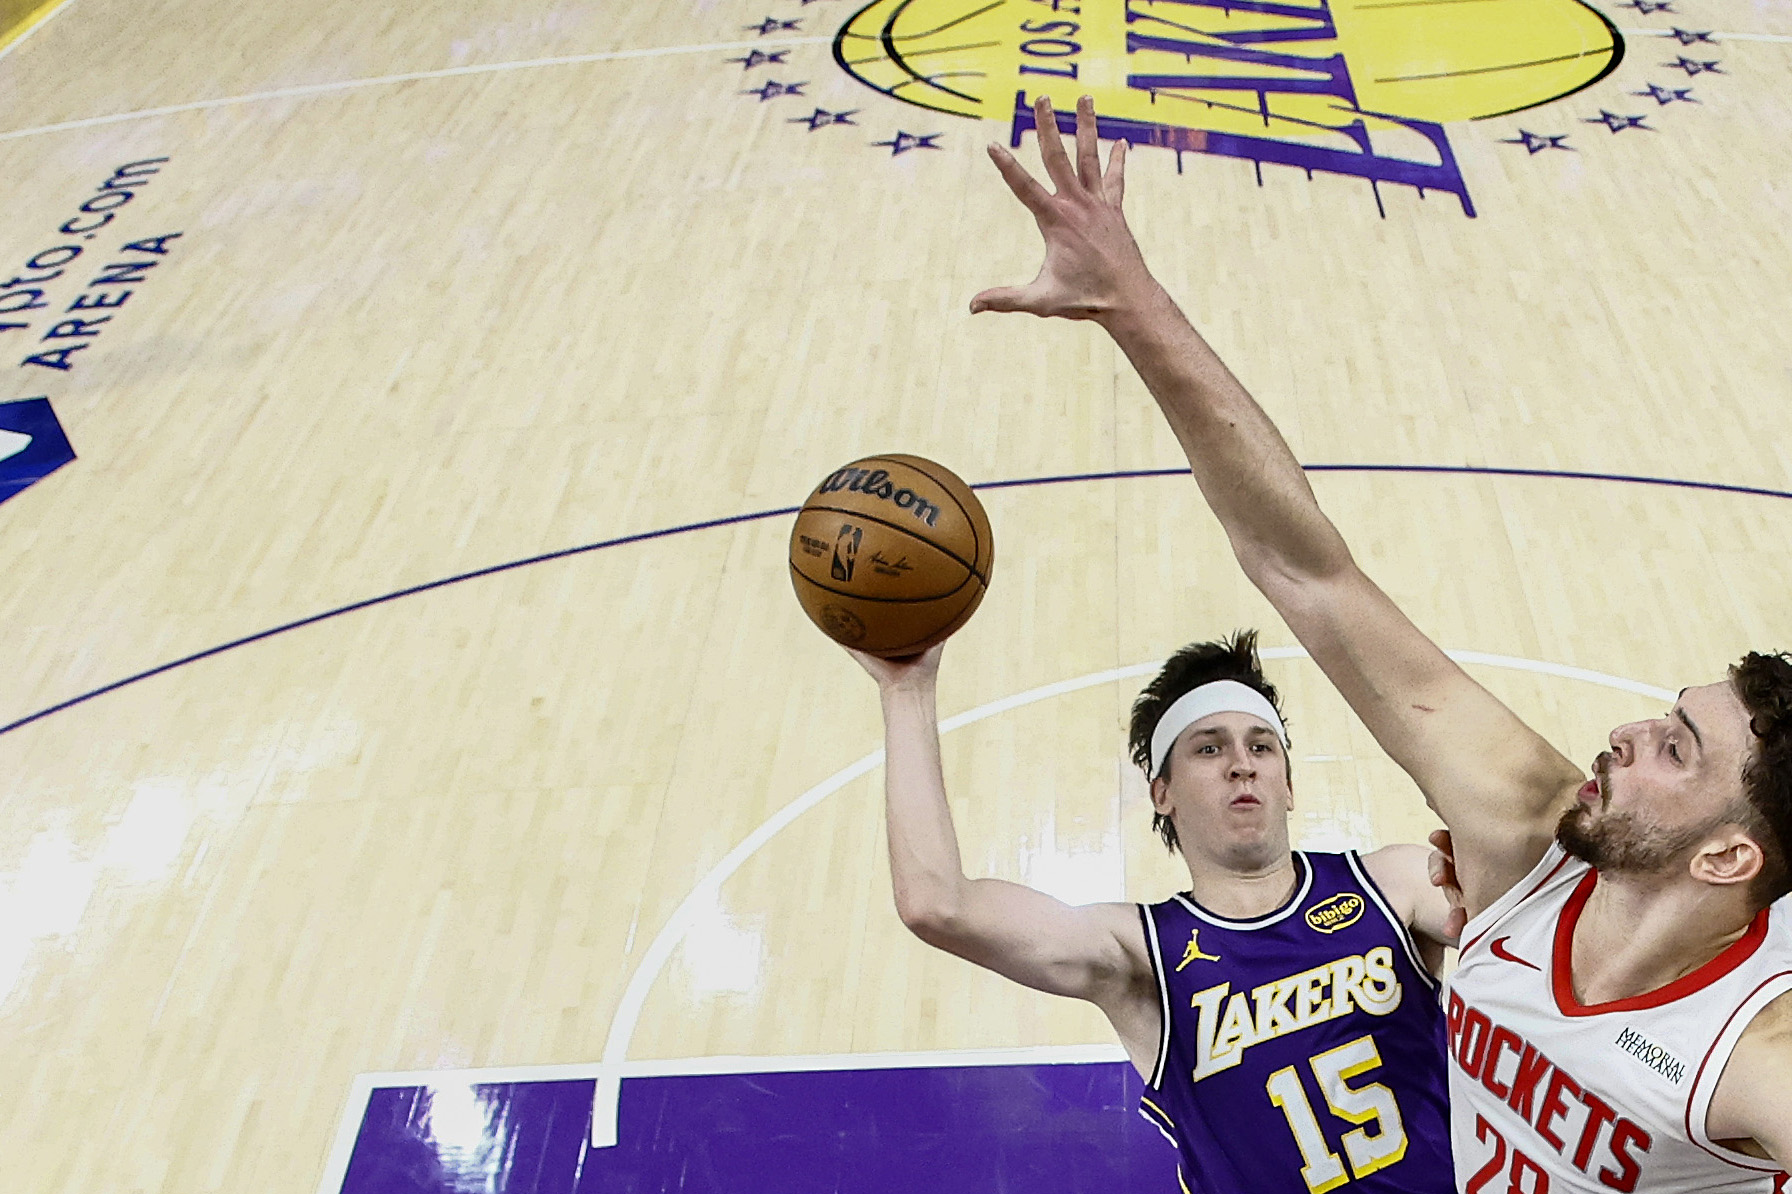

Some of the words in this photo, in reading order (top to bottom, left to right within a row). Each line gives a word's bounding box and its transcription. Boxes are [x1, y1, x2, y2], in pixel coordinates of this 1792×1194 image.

[1019, 20, 1082, 80] LOS
[19, 231, 184, 371] ARENA
[820, 467, 939, 527] Wilson
[1309, 898, 1359, 925] bibigo
[1191, 946, 1402, 1083] LAKERS
[1615, 1036, 1682, 1085] HERMANN
[1618, 1026, 1686, 1078] MEMORIAL
[1447, 985, 1653, 1194] ROCKETS
